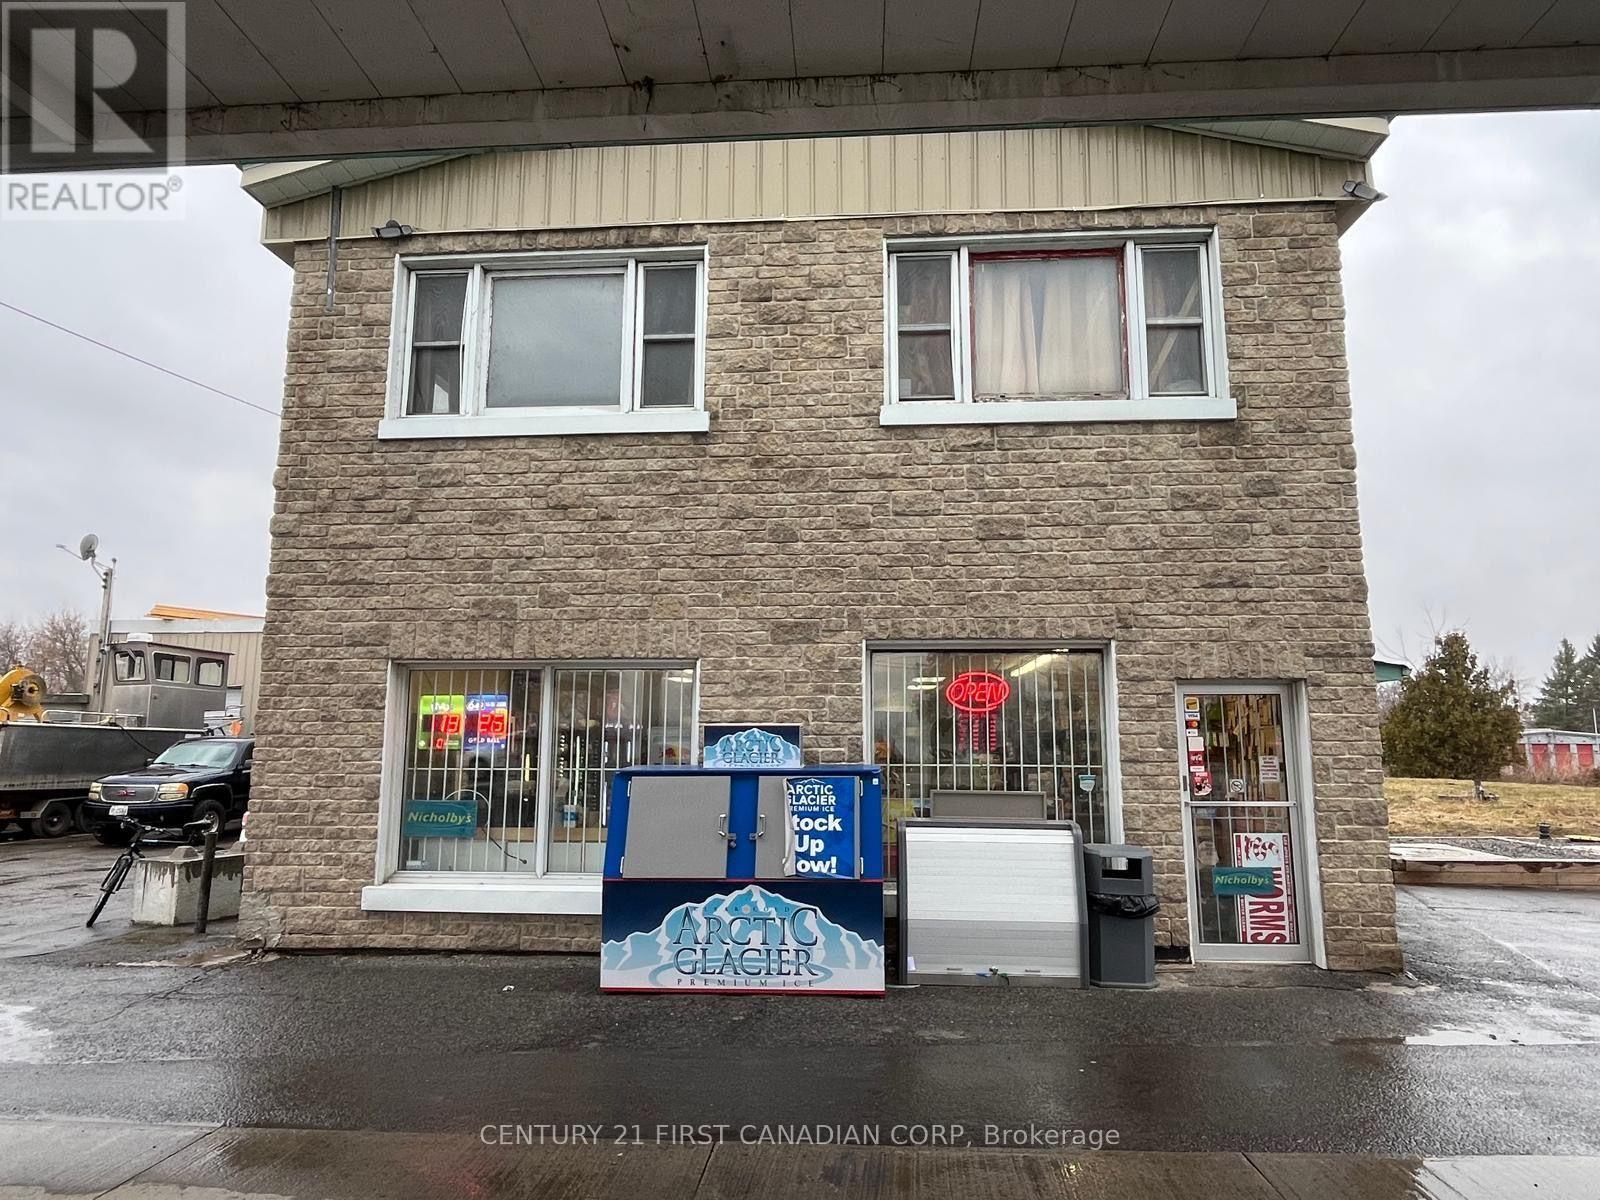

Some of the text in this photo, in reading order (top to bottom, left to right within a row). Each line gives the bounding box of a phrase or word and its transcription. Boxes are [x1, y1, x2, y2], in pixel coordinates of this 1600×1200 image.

[950, 682, 1004, 702] OPEN
[722, 736, 782, 753] ARCTIC
[722, 751, 782, 764] GLACIER
[786, 785, 834, 795] ARCTIC
[792, 813, 843, 832] tock
[794, 834, 825, 857] Up
[796, 856, 837, 874] ow!
[673, 906, 819, 946] ARCTIC
[673, 947, 819, 976] GLACIER
[677, 978, 814, 988] PREMIUM ICE
